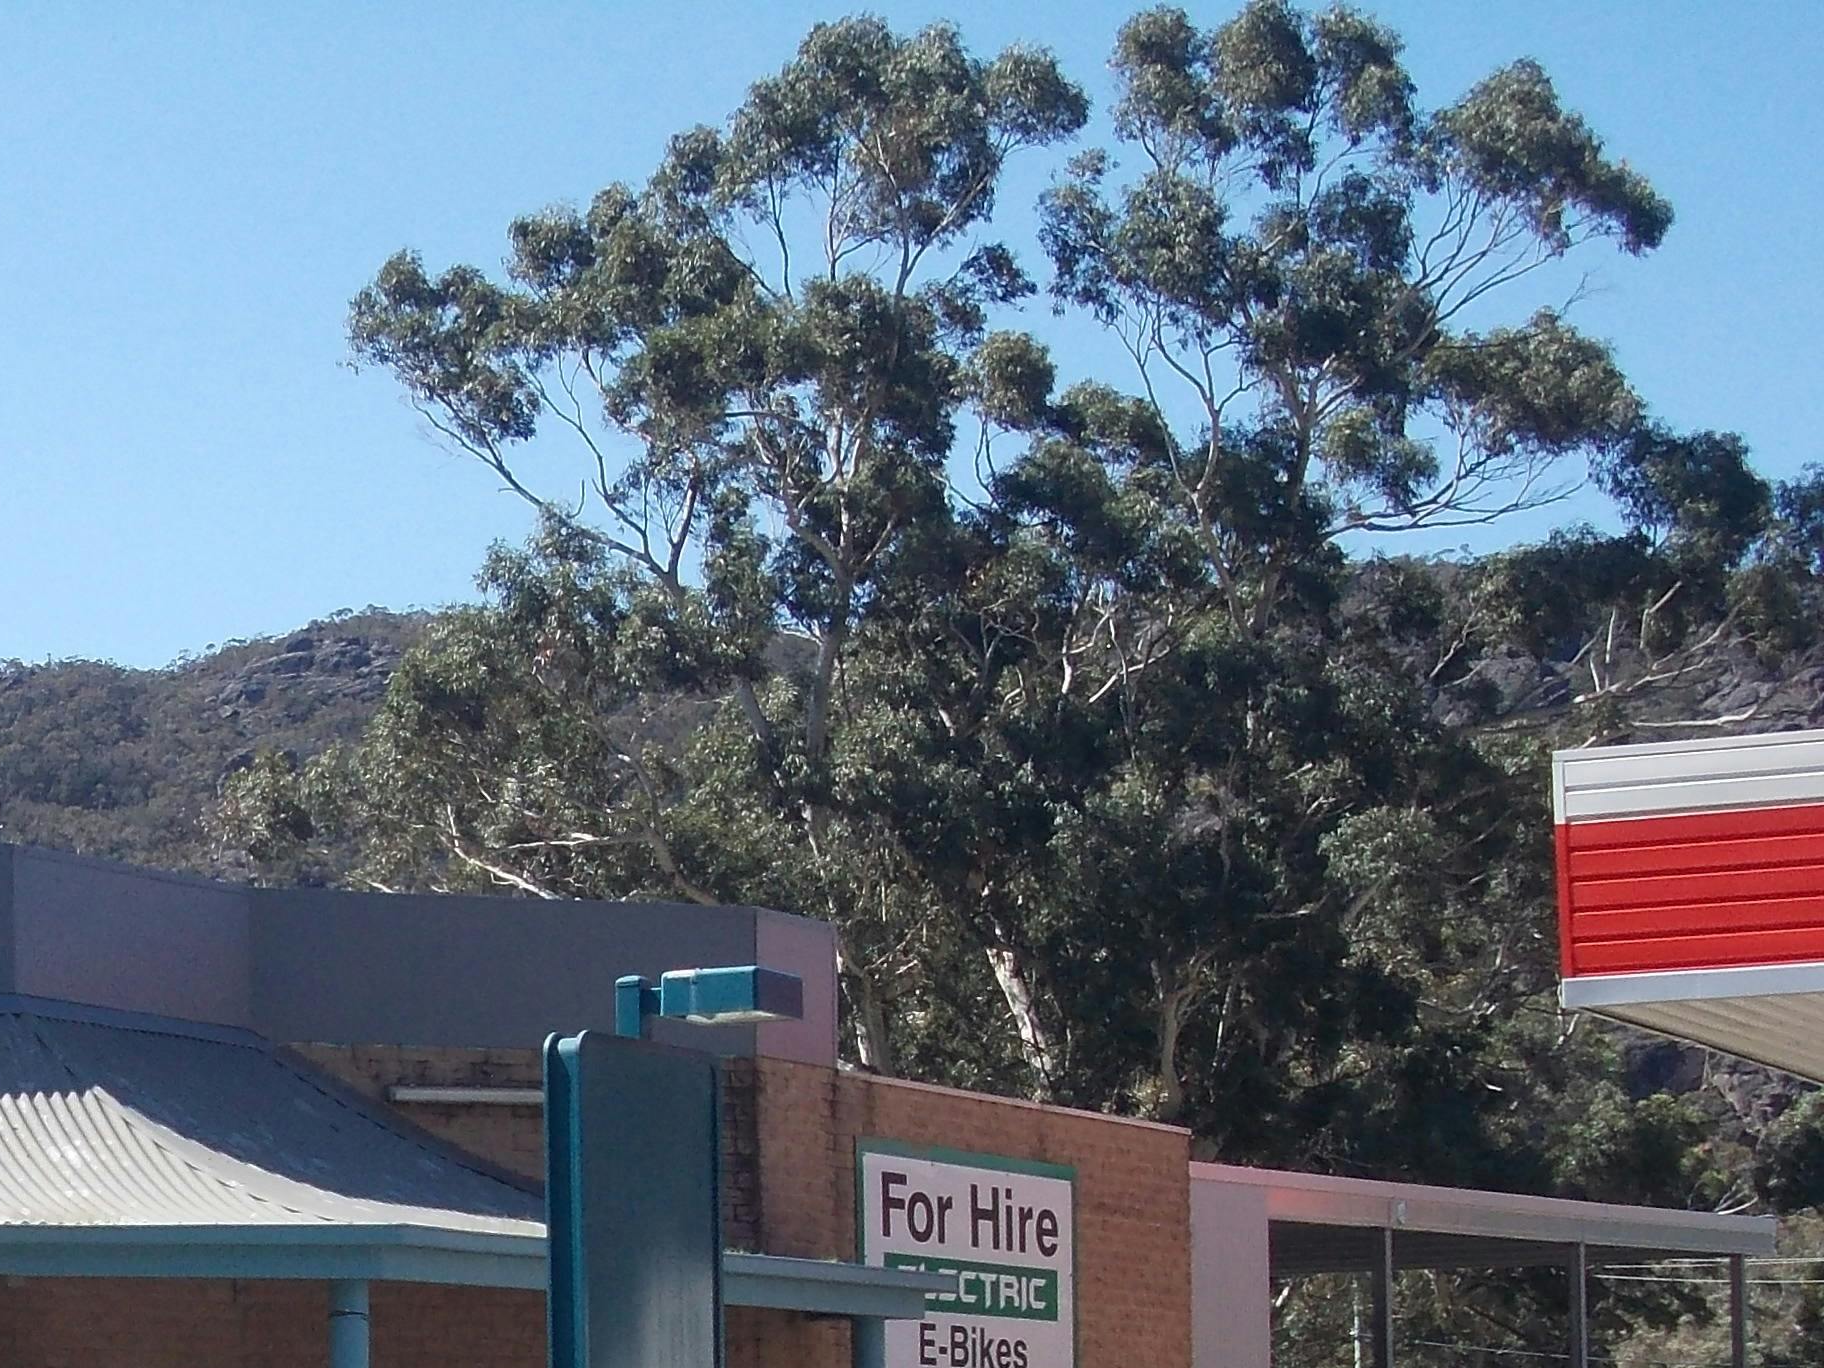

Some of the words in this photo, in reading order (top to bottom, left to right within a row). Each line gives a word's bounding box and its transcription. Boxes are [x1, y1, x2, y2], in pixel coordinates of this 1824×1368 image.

[881, 1171, 953, 1244] For
[970, 1183, 1059, 1257] Hire
[898, 1263, 1046, 1312] CTRIC
